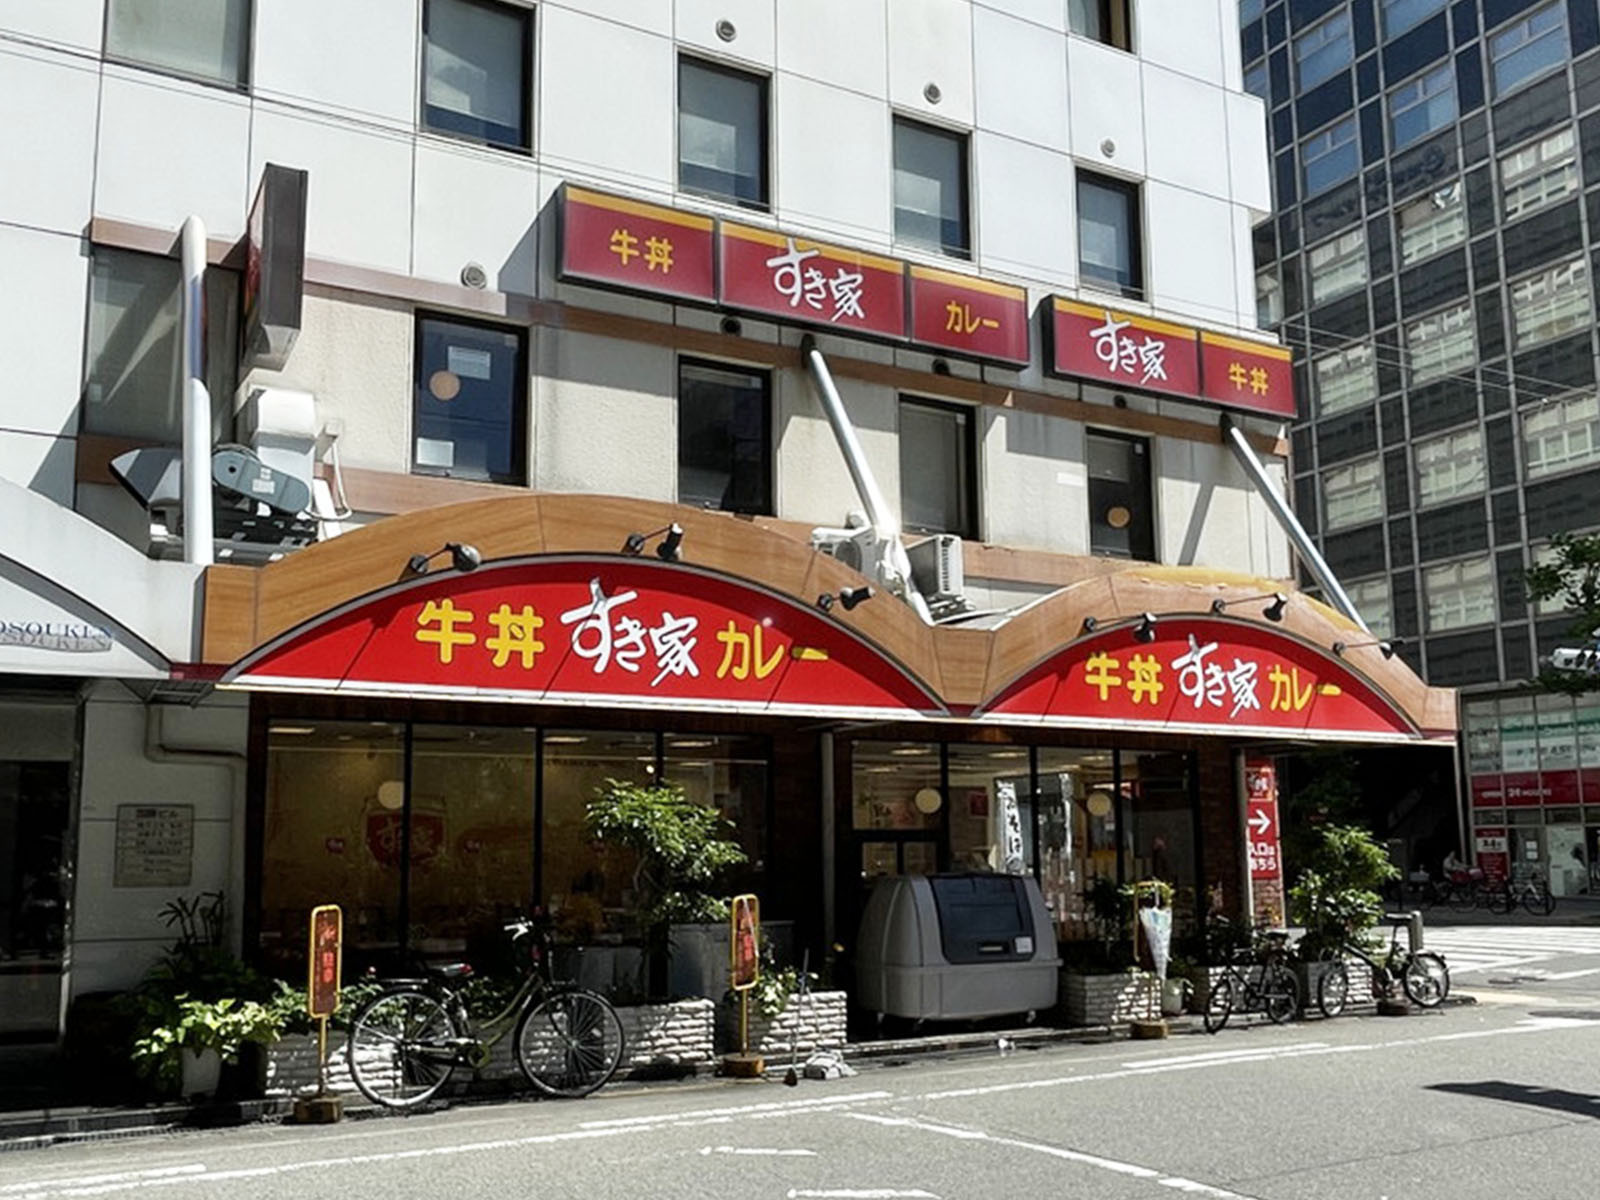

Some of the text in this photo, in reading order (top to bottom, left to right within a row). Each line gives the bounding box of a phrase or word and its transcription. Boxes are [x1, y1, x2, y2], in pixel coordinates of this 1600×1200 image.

[609, 229, 675, 274] 牛丼
[765, 237, 865, 323] すき家
[945, 300, 1000, 335] カレー
[1089, 311, 1168, 385] すき家
[1228, 362, 1269, 397] 牛丼
[415, 578, 830, 688] 牛丼 すき家 カレー
[1084, 633, 1342, 719] 牛丼 すき家 カレー
